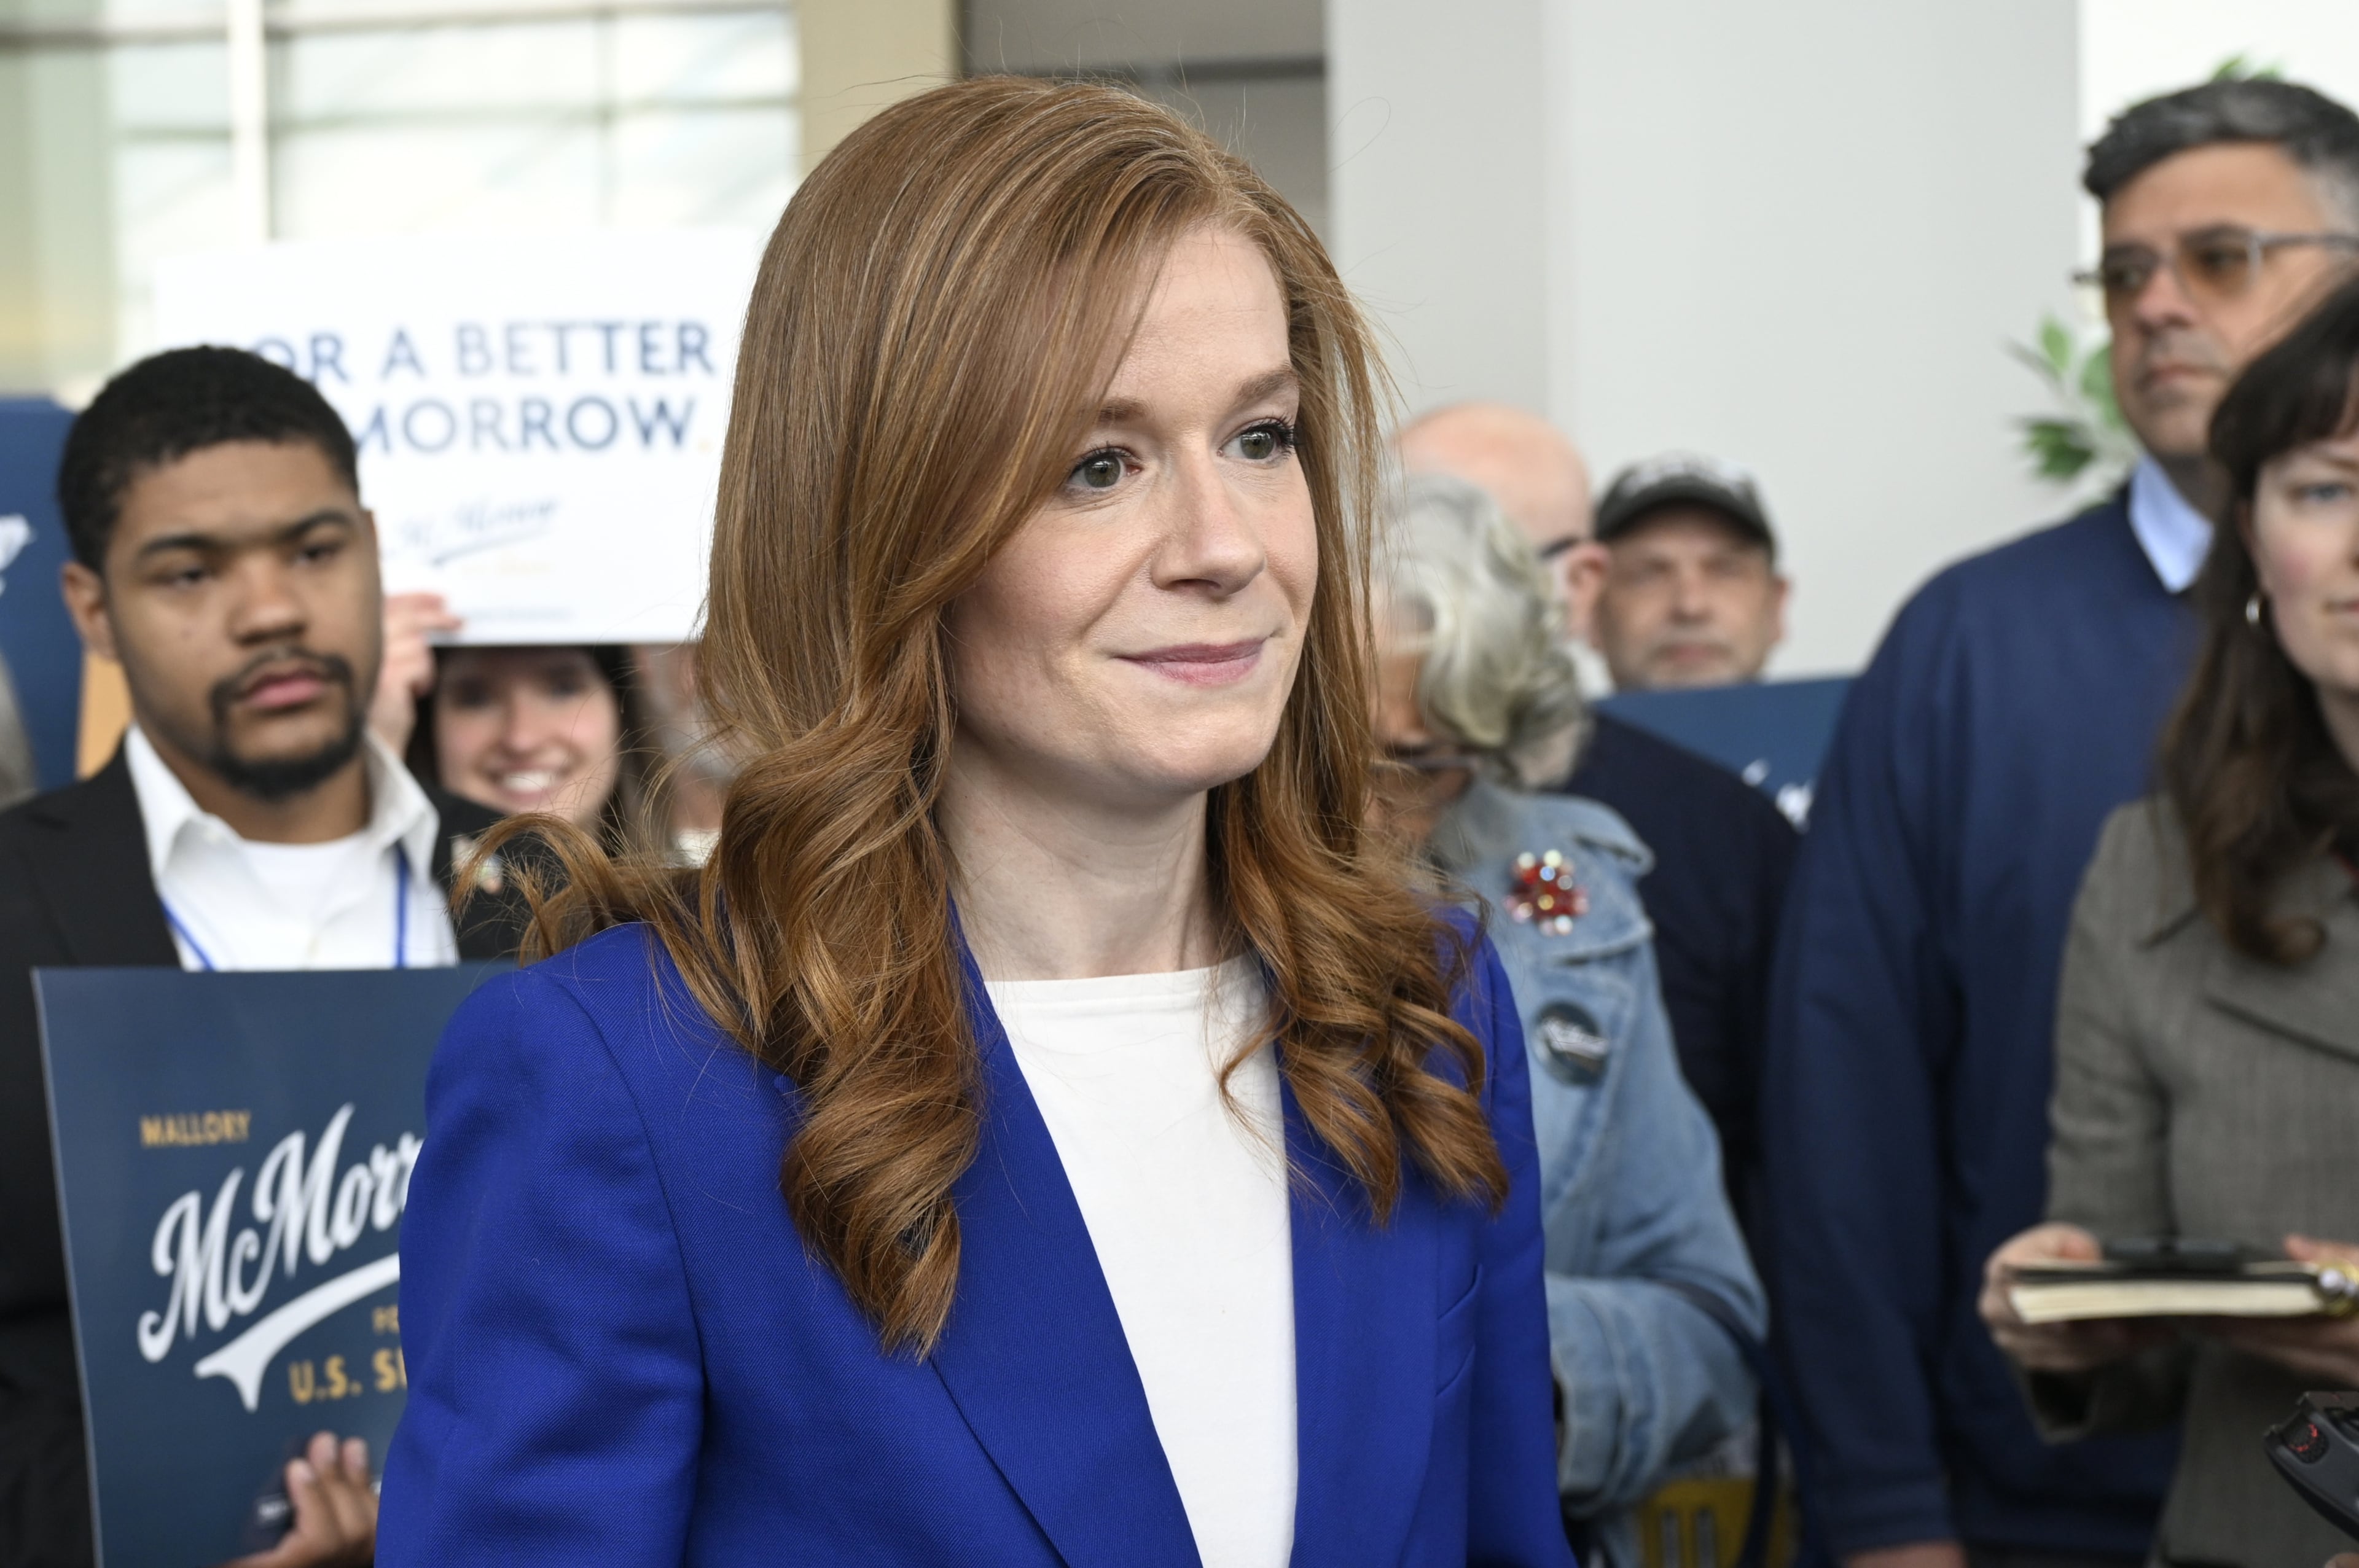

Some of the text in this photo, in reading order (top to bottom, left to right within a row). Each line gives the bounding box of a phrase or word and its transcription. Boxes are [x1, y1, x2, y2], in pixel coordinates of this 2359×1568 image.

[253, 319, 716, 386] OR A BETTER
[358, 396, 713, 456] MORROW.
[140, 1110, 251, 1148] MALLORY
[138, 1103, 425, 1362] McMorr
[288, 1355, 362, 1404] U.S.
